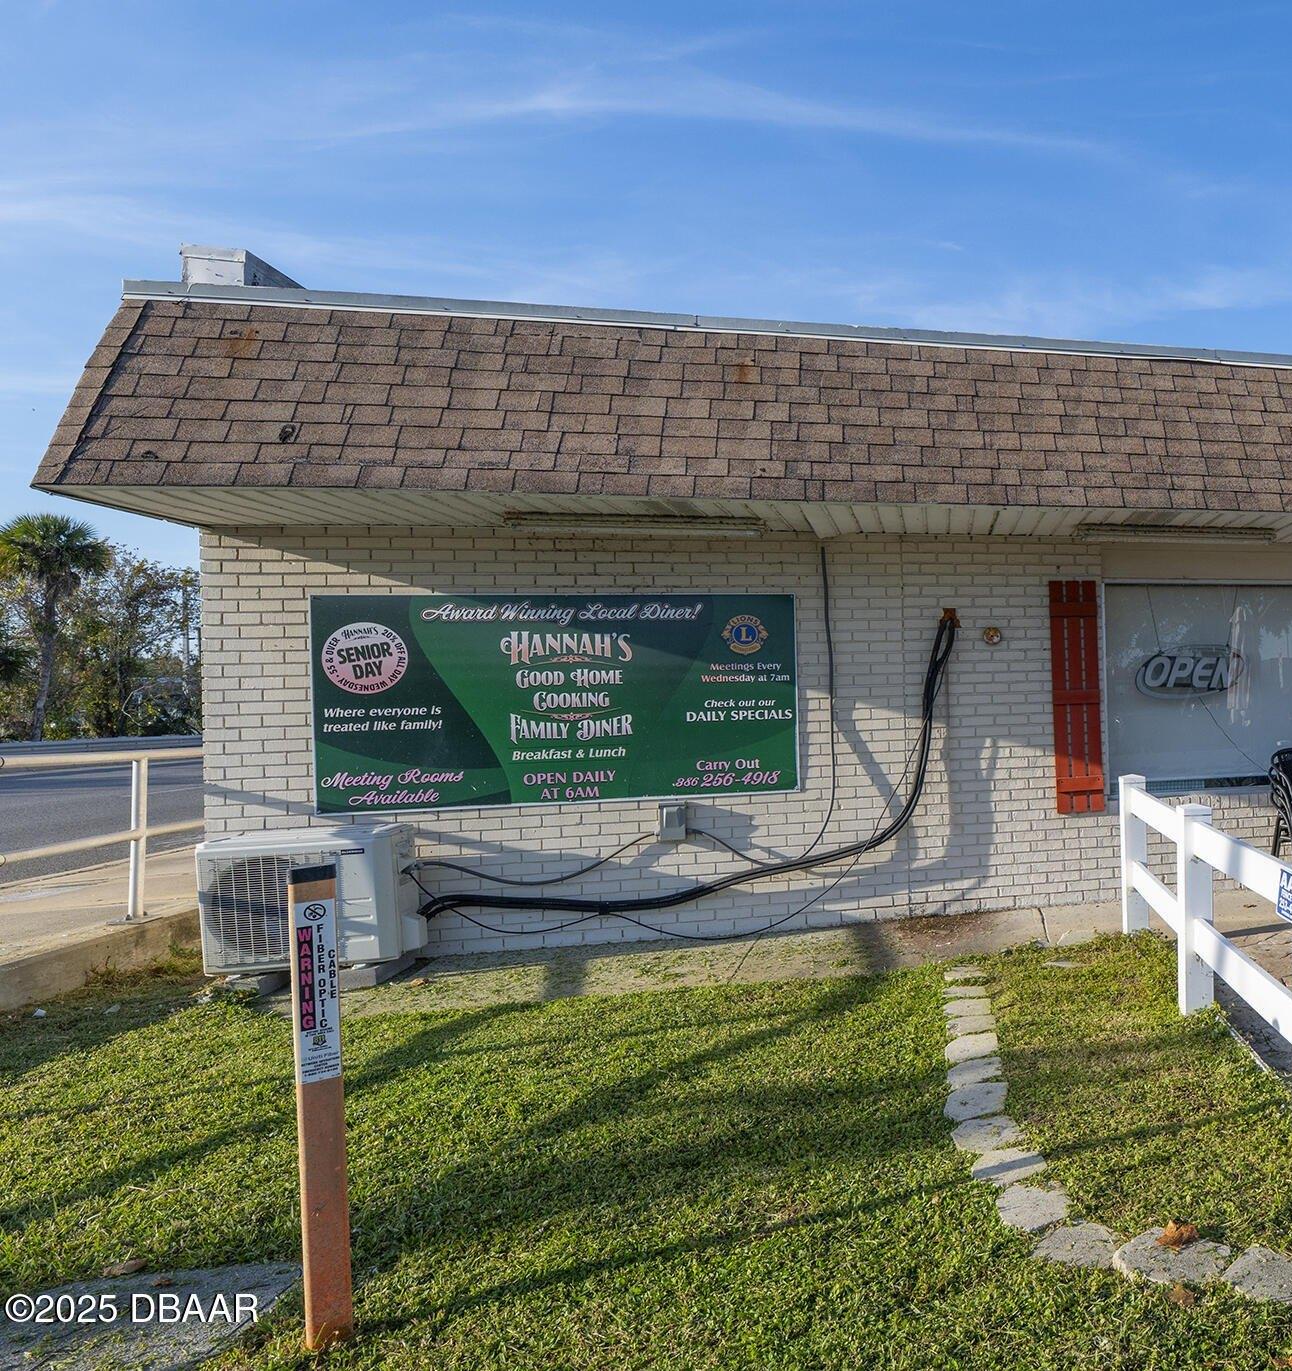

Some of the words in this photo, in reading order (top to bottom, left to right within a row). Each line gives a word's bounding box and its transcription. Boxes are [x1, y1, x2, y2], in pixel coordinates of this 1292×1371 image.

[421, 603, 499, 621] Award
[500, 602, 575, 626] Winning
[579, 603, 636, 621] Local
[637, 602, 703, 620] Diner!
[341, 626, 379, 640] HANNAH'S
[381, 629, 398, 643] 20%
[740, 627, 752, 641] L
[326, 637, 340, 655] OVER
[336, 641, 393, 665] SENIOR
[394, 642, 406, 655] OFF
[500, 631, 633, 666] HANNAH'S
[327, 665, 338, 674] 55
[396, 656, 406, 668] ALL
[710, 663, 754, 671] Meetings
[757, 662, 782, 671] Every
[352, 660, 383, 680] DAY
[388, 669, 402, 683] DAY
[1144, 655, 1231, 689] OPEN
[338, 678, 388, 692] WEDNESDAY
[515, 669, 565, 689] GOOD
[570, 668, 623, 688] HOME
[701, 674, 756, 683] Wednesday
[758, 674, 767, 682] at
[770, 673, 790, 681] 7am
[533, 691, 610, 711] COOKING
[704, 699, 735, 708] Check
[738, 699, 755, 707] out
[758, 699, 776, 707] our
[323, 707, 366, 718] Where
[369, 706, 427, 718] everyone
[431, 705, 442, 716] is
[686, 711, 727, 722] DAILY
[731, 709, 793, 721] SPECIALS
[323, 721, 370, 733] treated
[373, 720, 397, 731] like
[400, 719, 443, 732] family!
[510, 713, 570, 745] FAMILY
[576, 714, 633, 741] DINER
[512, 748, 572, 761] Breakfast
[576, 749, 585, 758] &
[589, 746, 626, 759] Lunch
[696, 759, 731, 772] Carry
[735, 758, 760, 770] Out
[321, 771, 393, 791] Meeting
[397, 768, 464, 785] Rooms
[523, 772, 567, 786] OPEN
[572, 770, 616, 784] DAILY
[700, 770, 781, 788] 256-4918
[348, 788, 440, 806] Available
[540, 787, 560, 800] AT
[565, 786, 600, 799] 6AM
[317, 923, 326, 973] FIBER
[298, 927, 315, 1029] WARNING
[327, 949, 337, 999] CABLE
[318, 978, 328, 1028] OPTIC
